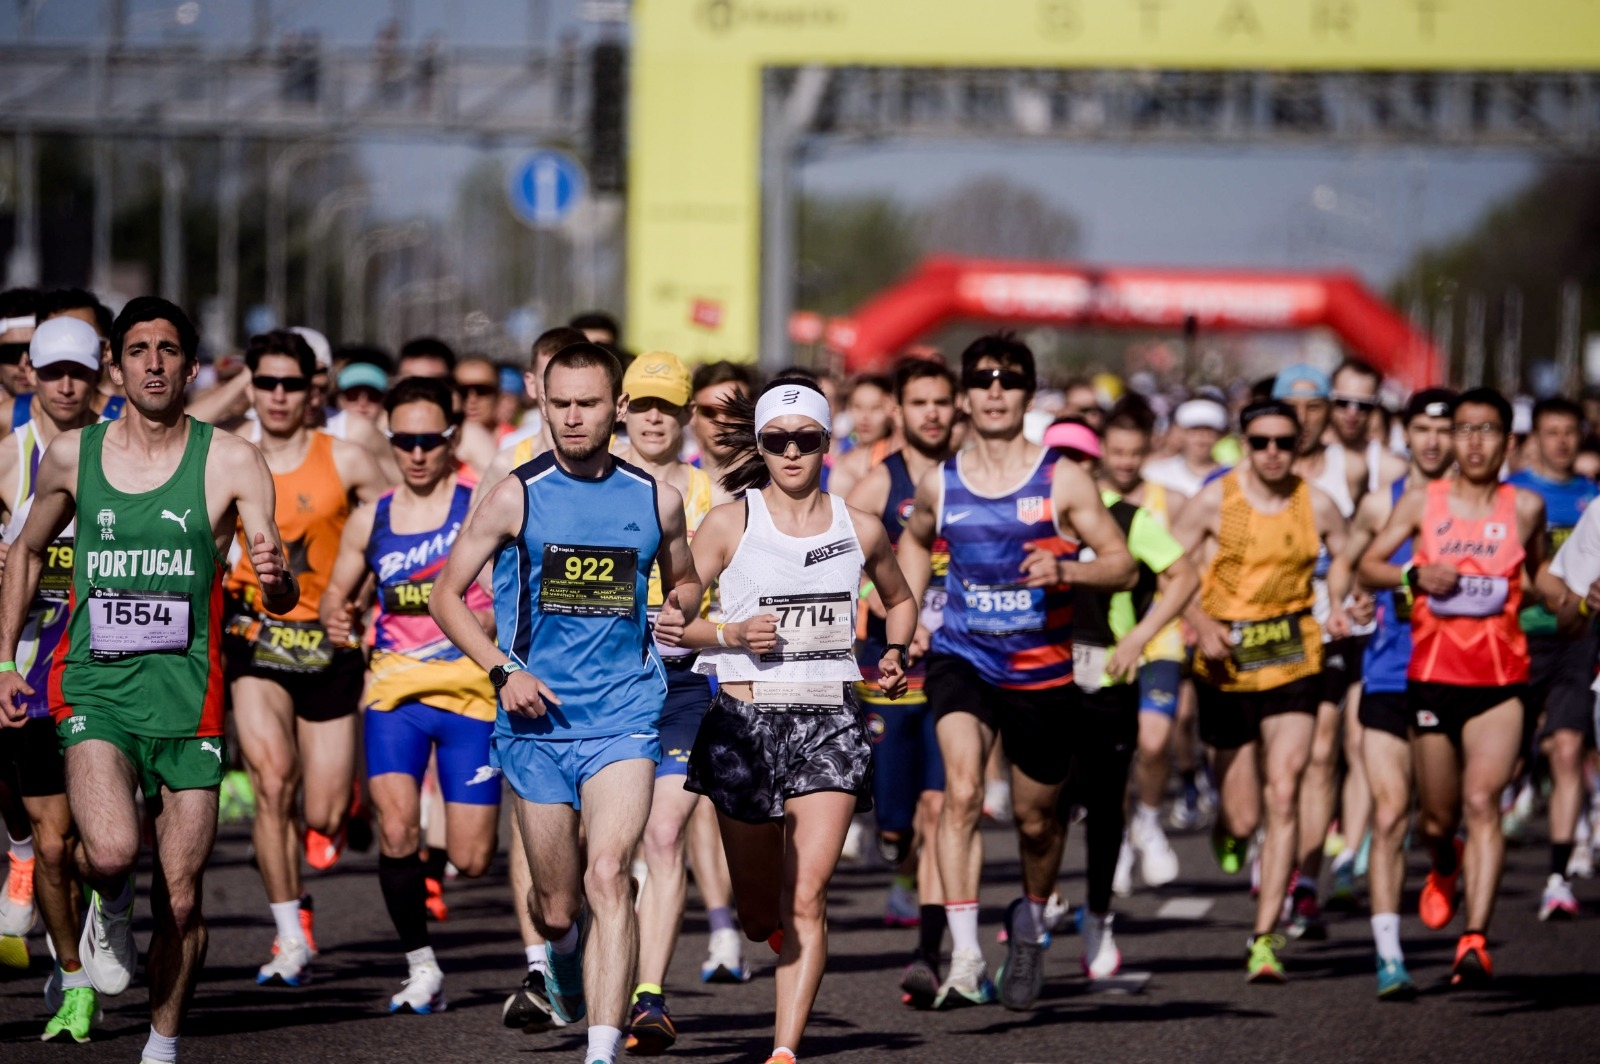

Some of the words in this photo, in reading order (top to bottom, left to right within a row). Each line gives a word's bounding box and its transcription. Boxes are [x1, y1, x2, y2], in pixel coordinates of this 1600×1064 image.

[1035, 0, 1450, 44] START
[100, 533, 116, 541] FPA
[1439, 539, 1499, 557] JAPAN
[87, 548, 195, 579] PORTUGAL
[564, 556, 614, 582] 922
[977, 589, 1032, 613] 3138
[102, 602, 172, 626] 1554
[776, 605, 835, 628] 7714
[268, 626, 324, 651] 7947
